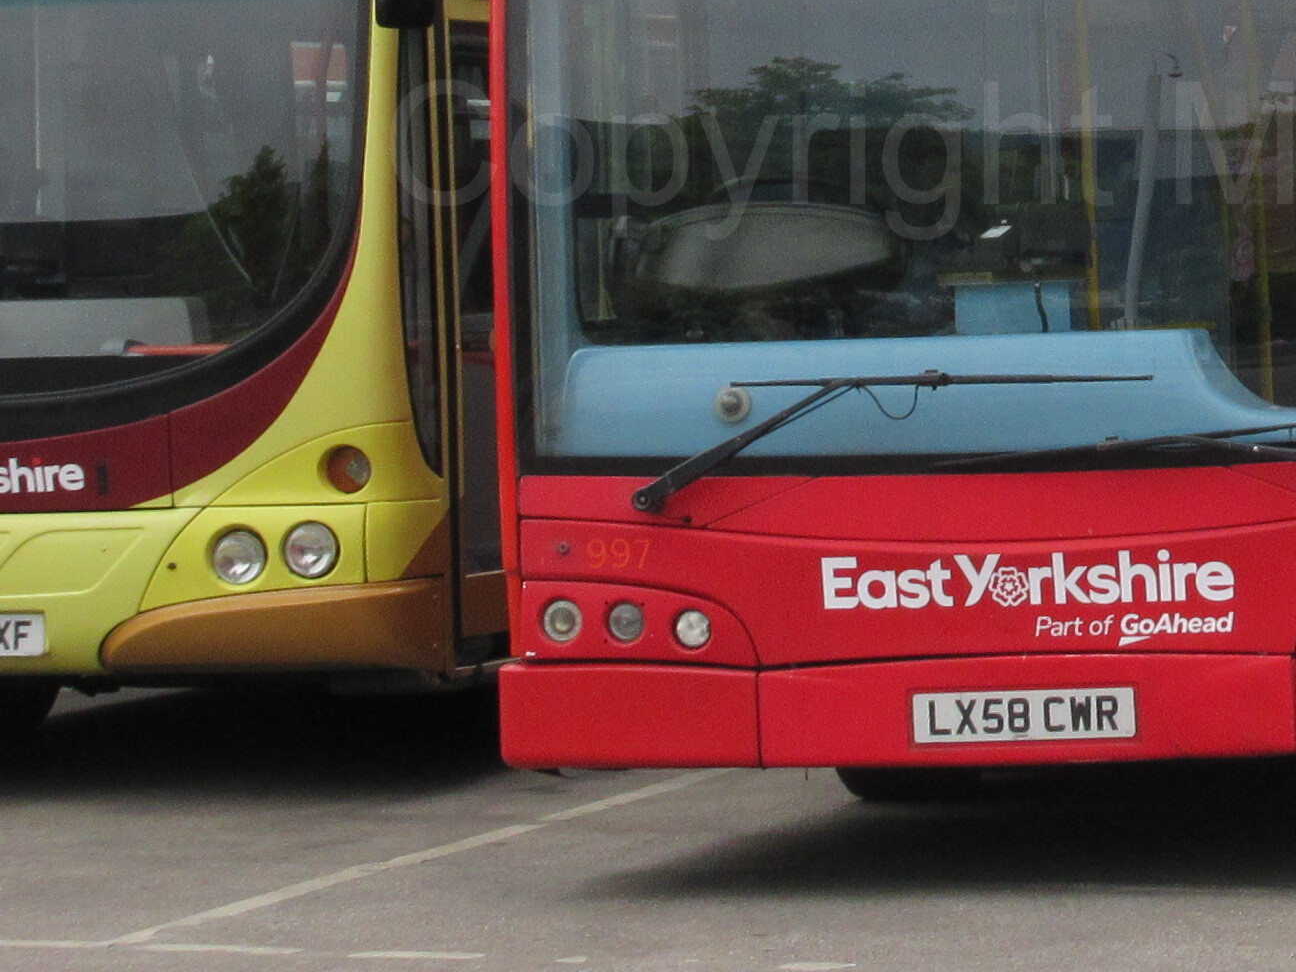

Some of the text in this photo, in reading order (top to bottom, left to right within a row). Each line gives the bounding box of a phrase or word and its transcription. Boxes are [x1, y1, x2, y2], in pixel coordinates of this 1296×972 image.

[587, 538, 652, 569] 997
[820, 557, 954, 610] East
[1035, 612, 1235, 637] Part of GoAhead
[928, 695, 1120, 736] LX58 CWR
